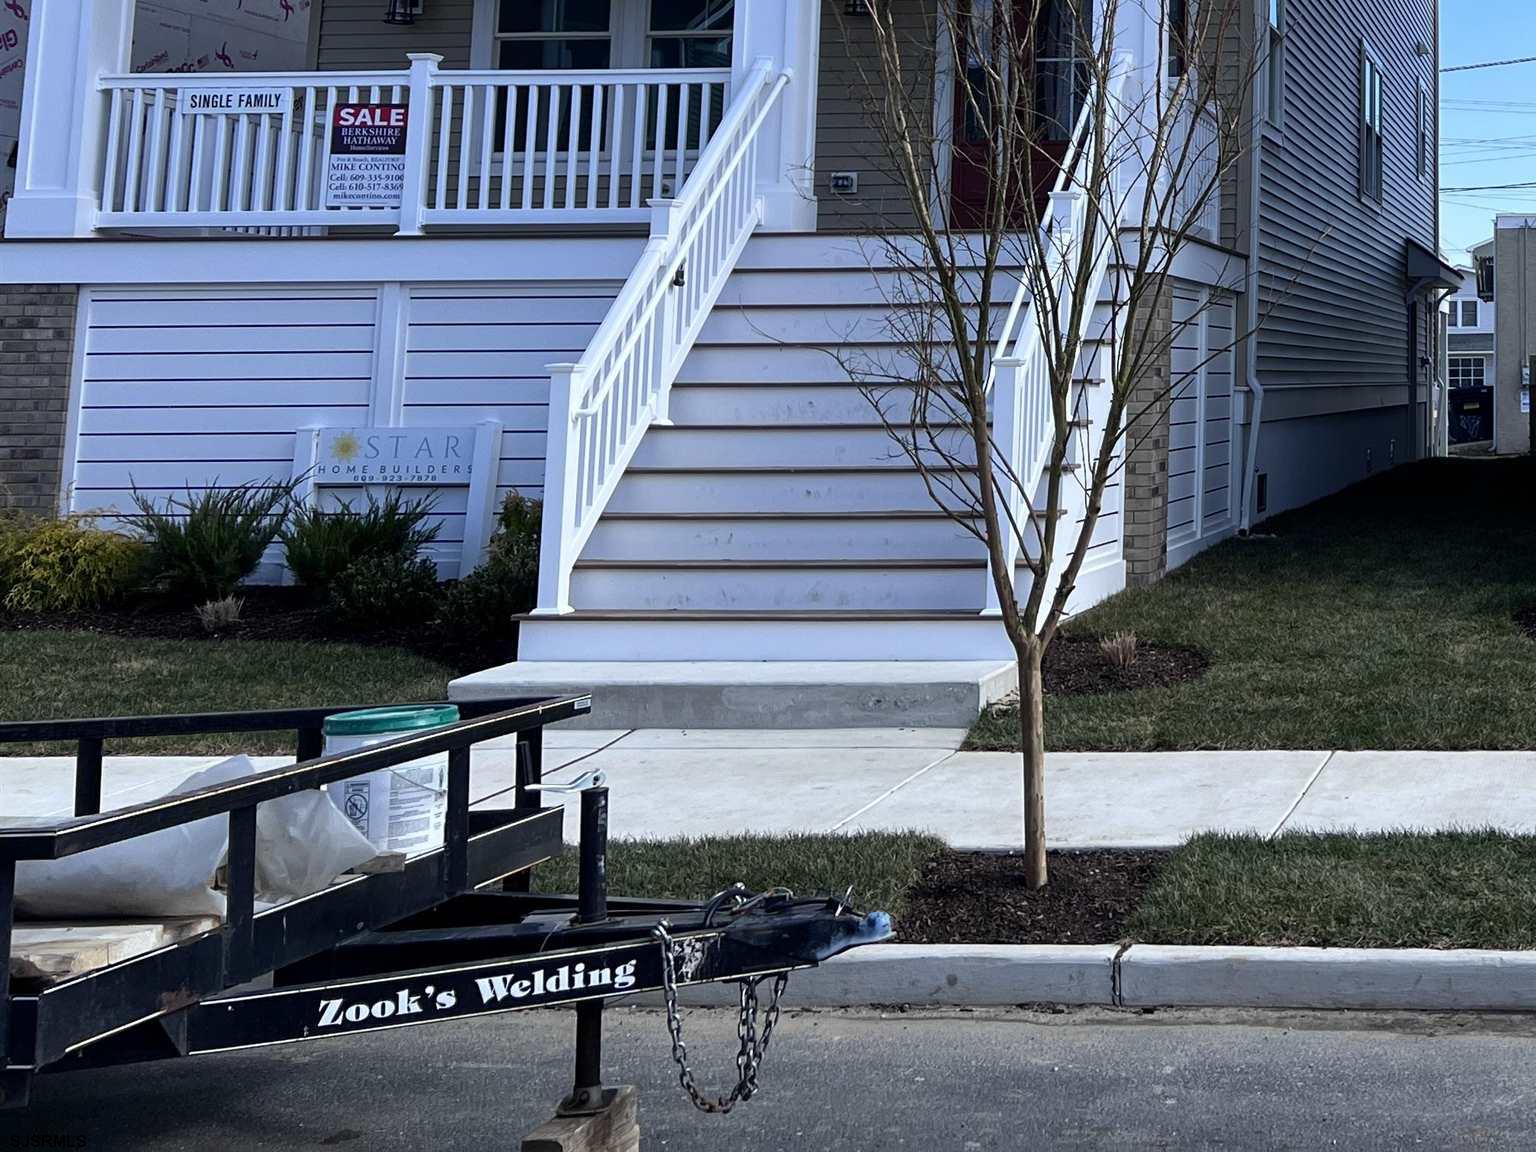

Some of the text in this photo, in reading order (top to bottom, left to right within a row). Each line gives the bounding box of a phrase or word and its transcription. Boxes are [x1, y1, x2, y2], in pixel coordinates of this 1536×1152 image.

[190, 94, 233, 108] SINGLE
[238, 93, 282, 108] FAMILY
[338, 108, 405, 126] SALE
[341, 127, 401, 136] BERKSHIRE
[343, 136, 398, 145] HATHAWAY
[331, 163, 405, 171] MIKE CONTINO
[364, 435, 462, 459] STAR
[318, 464, 473, 474] HOME BUILDERS
[317, 958, 637, 1028] Zook's Welding
